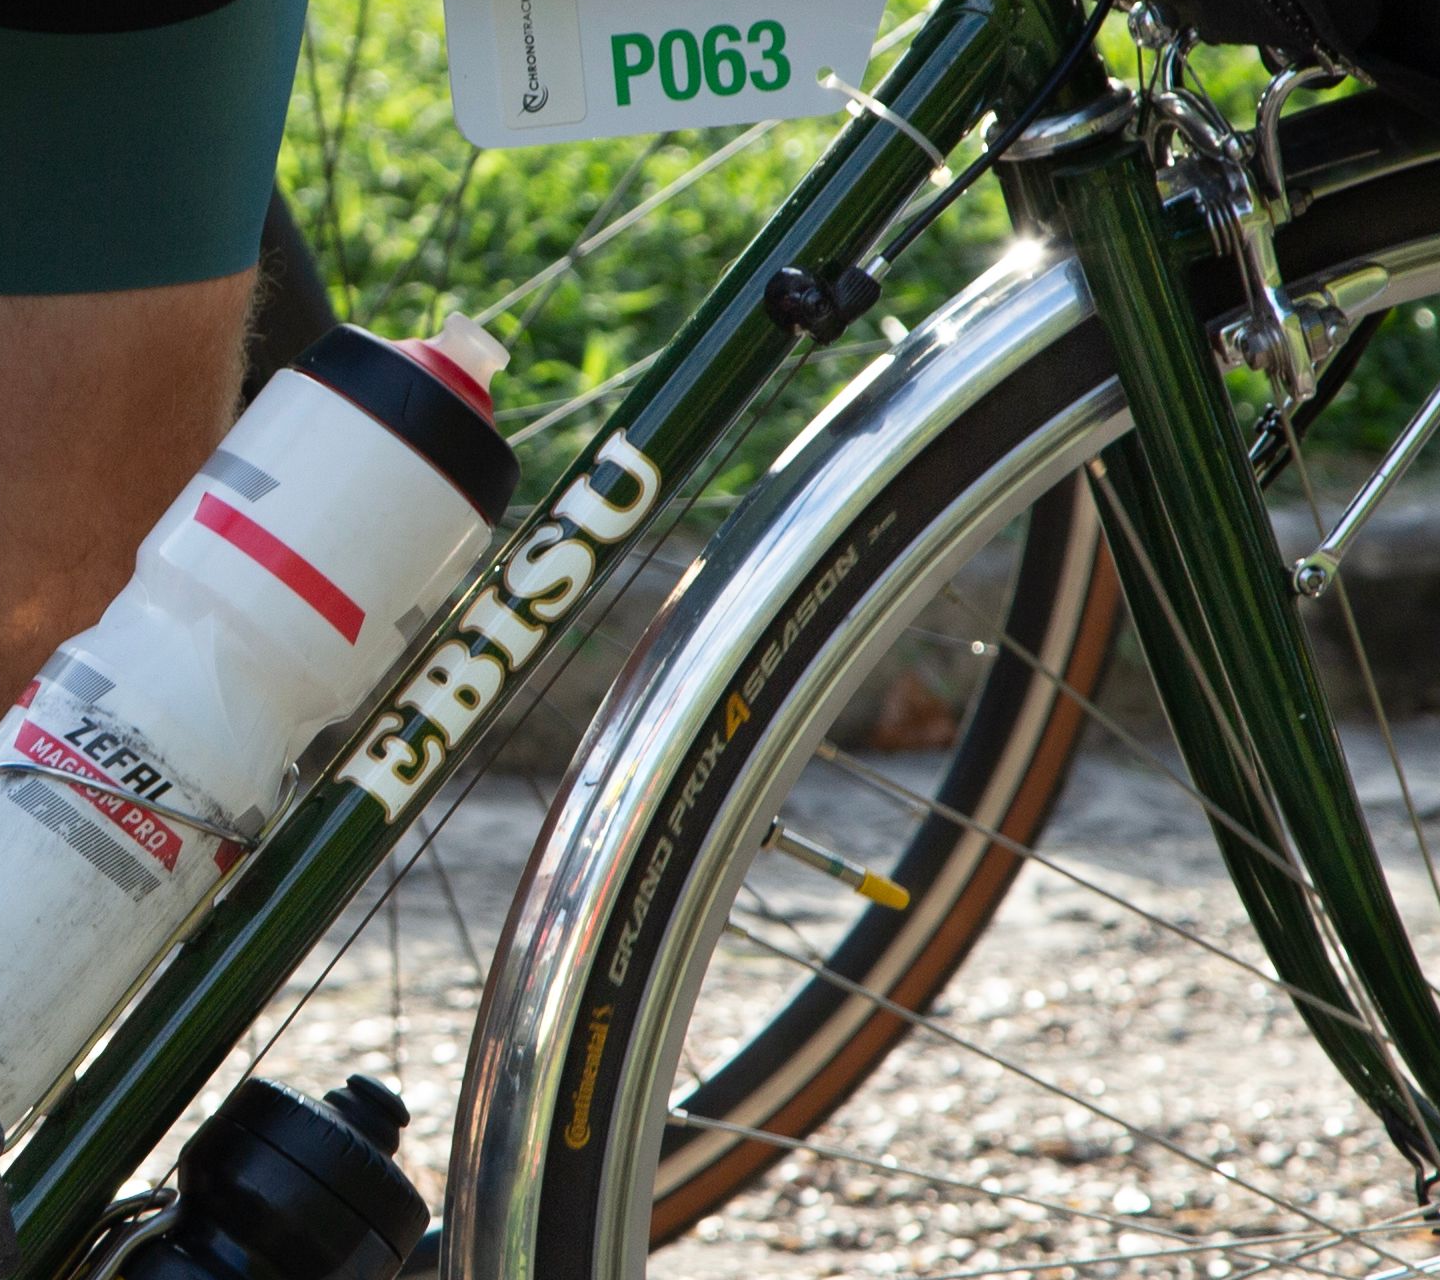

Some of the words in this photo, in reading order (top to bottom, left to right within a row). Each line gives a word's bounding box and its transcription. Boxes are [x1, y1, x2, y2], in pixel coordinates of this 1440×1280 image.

[610, 20, 792, 107] P063
[334, 427, 661, 824] EBISU
[121, 808, 169, 852] PRO
[608, 837, 673, 987] GRAND
[669, 730, 726, 835] PRIX
[725, 691, 751, 742] 4
[742, 544, 860, 704] SEASON
